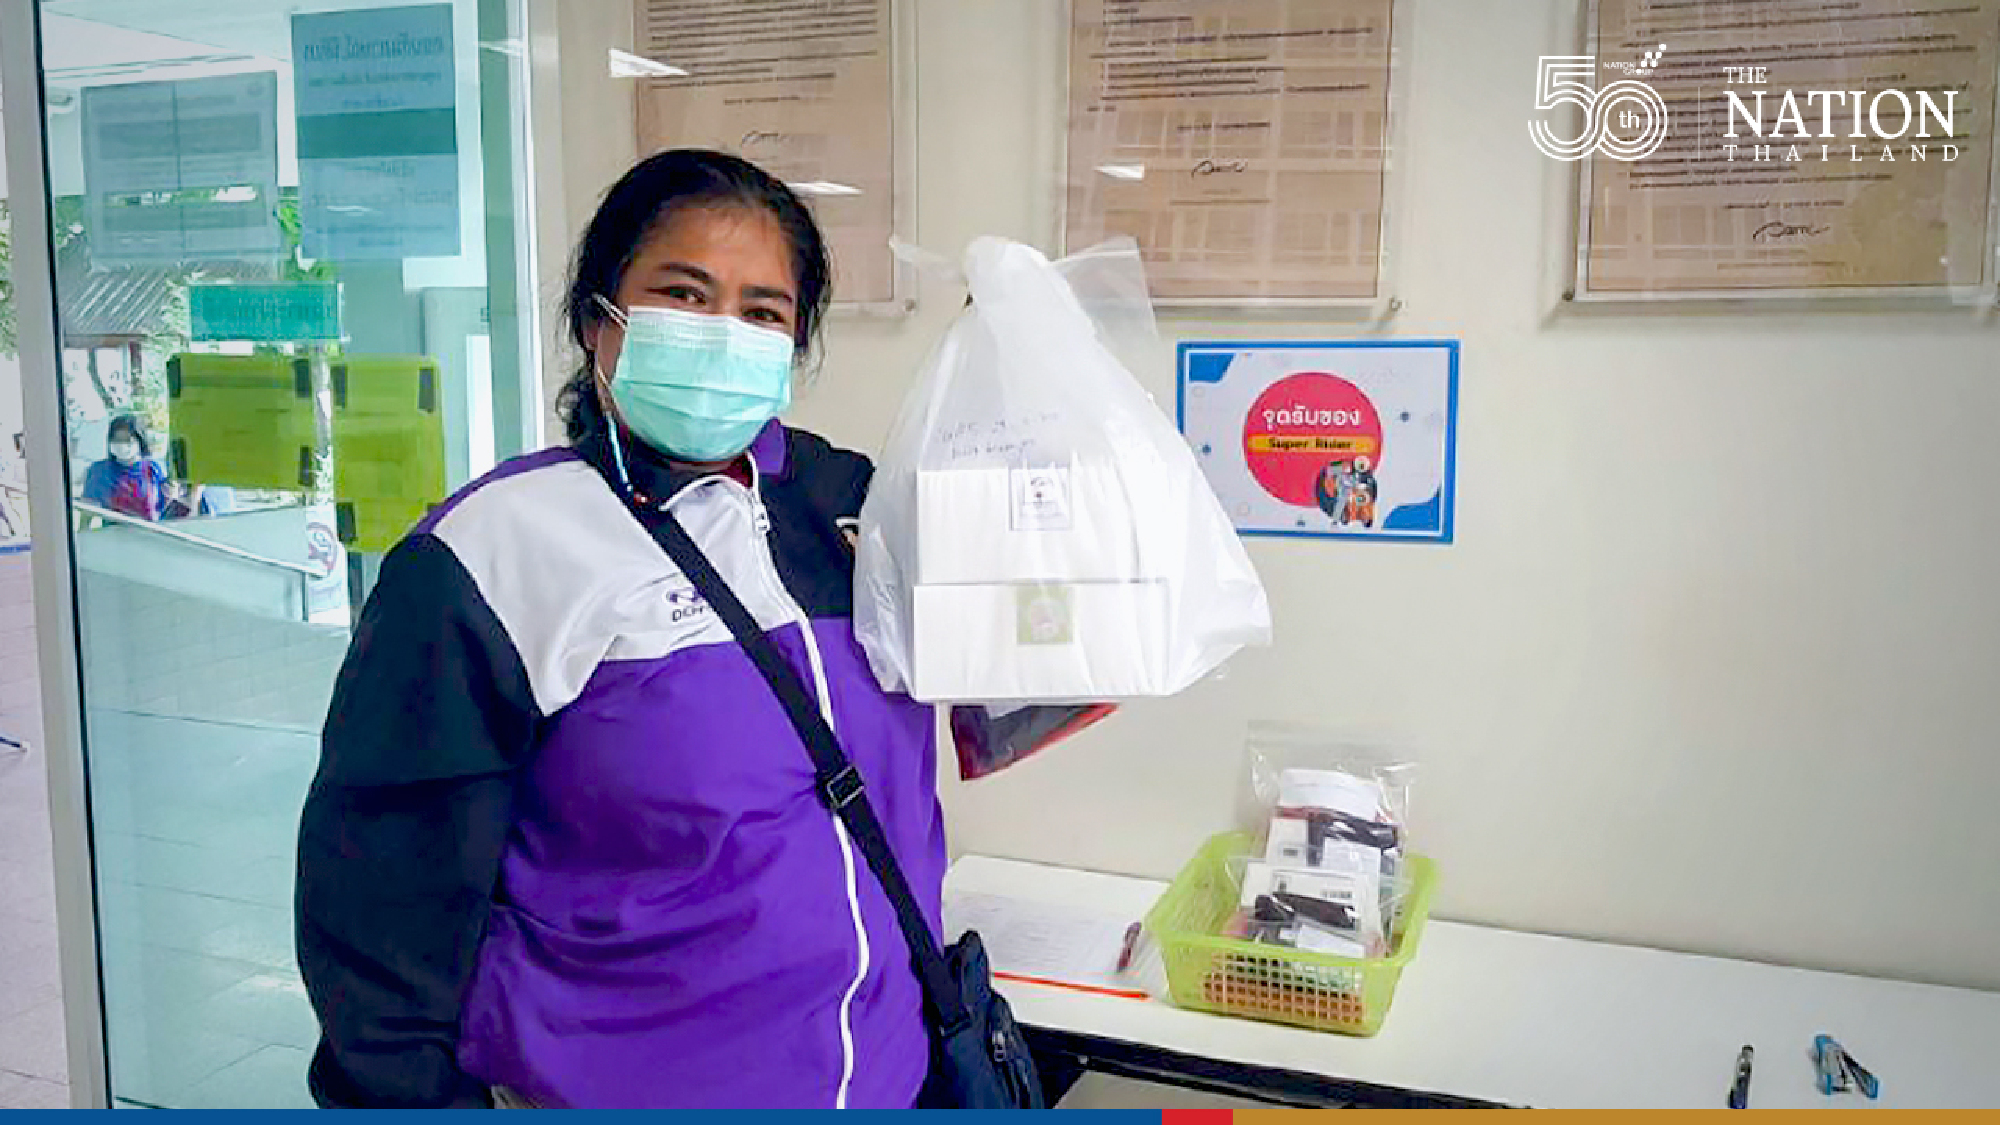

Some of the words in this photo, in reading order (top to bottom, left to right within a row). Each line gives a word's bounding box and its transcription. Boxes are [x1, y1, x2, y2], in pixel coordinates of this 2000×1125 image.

[1262, 404, 1361, 431] จุดรับของ
[1268, 437, 1309, 450] Super
